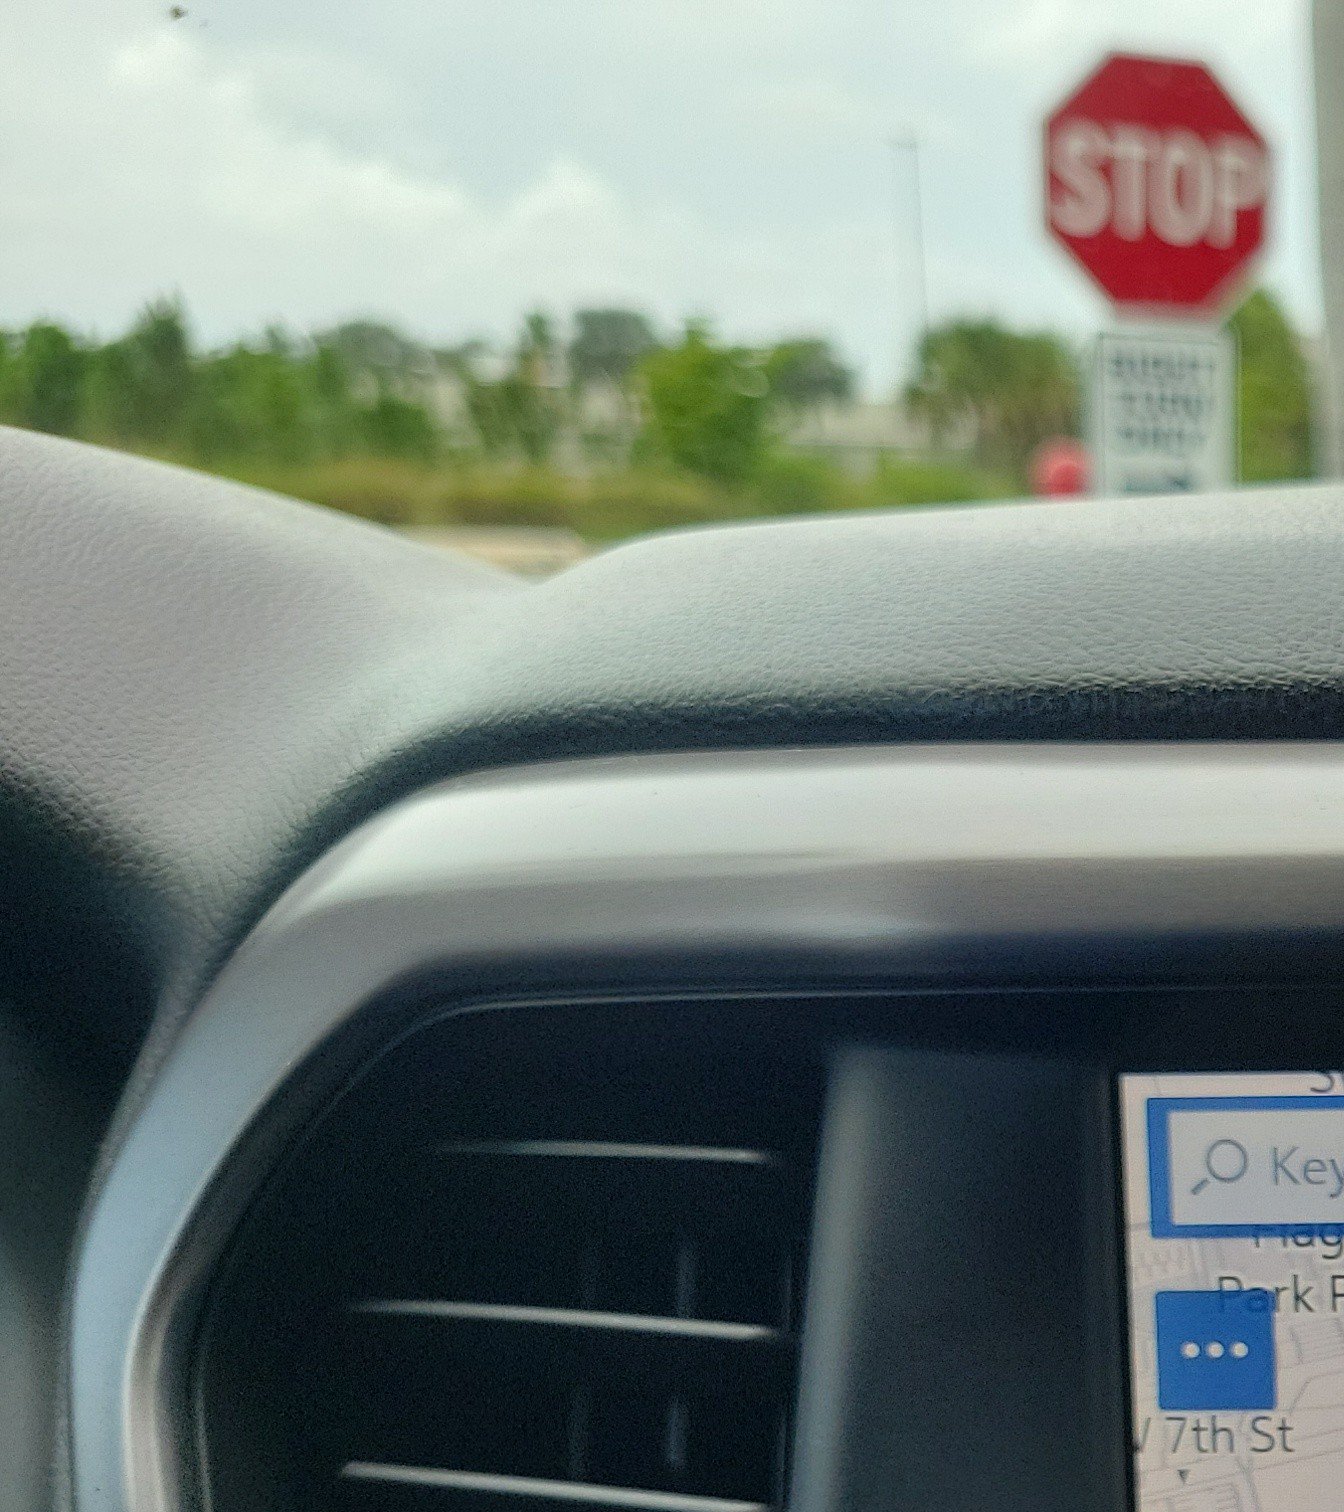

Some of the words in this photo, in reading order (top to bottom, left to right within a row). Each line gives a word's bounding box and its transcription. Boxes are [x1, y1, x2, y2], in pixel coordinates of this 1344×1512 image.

[1048, 118, 1267, 249] STOP
[1218, 1275, 1315, 1313] Park
[1165, 1416, 1236, 1454] 7th
[1249, 1416, 1296, 1453] St
